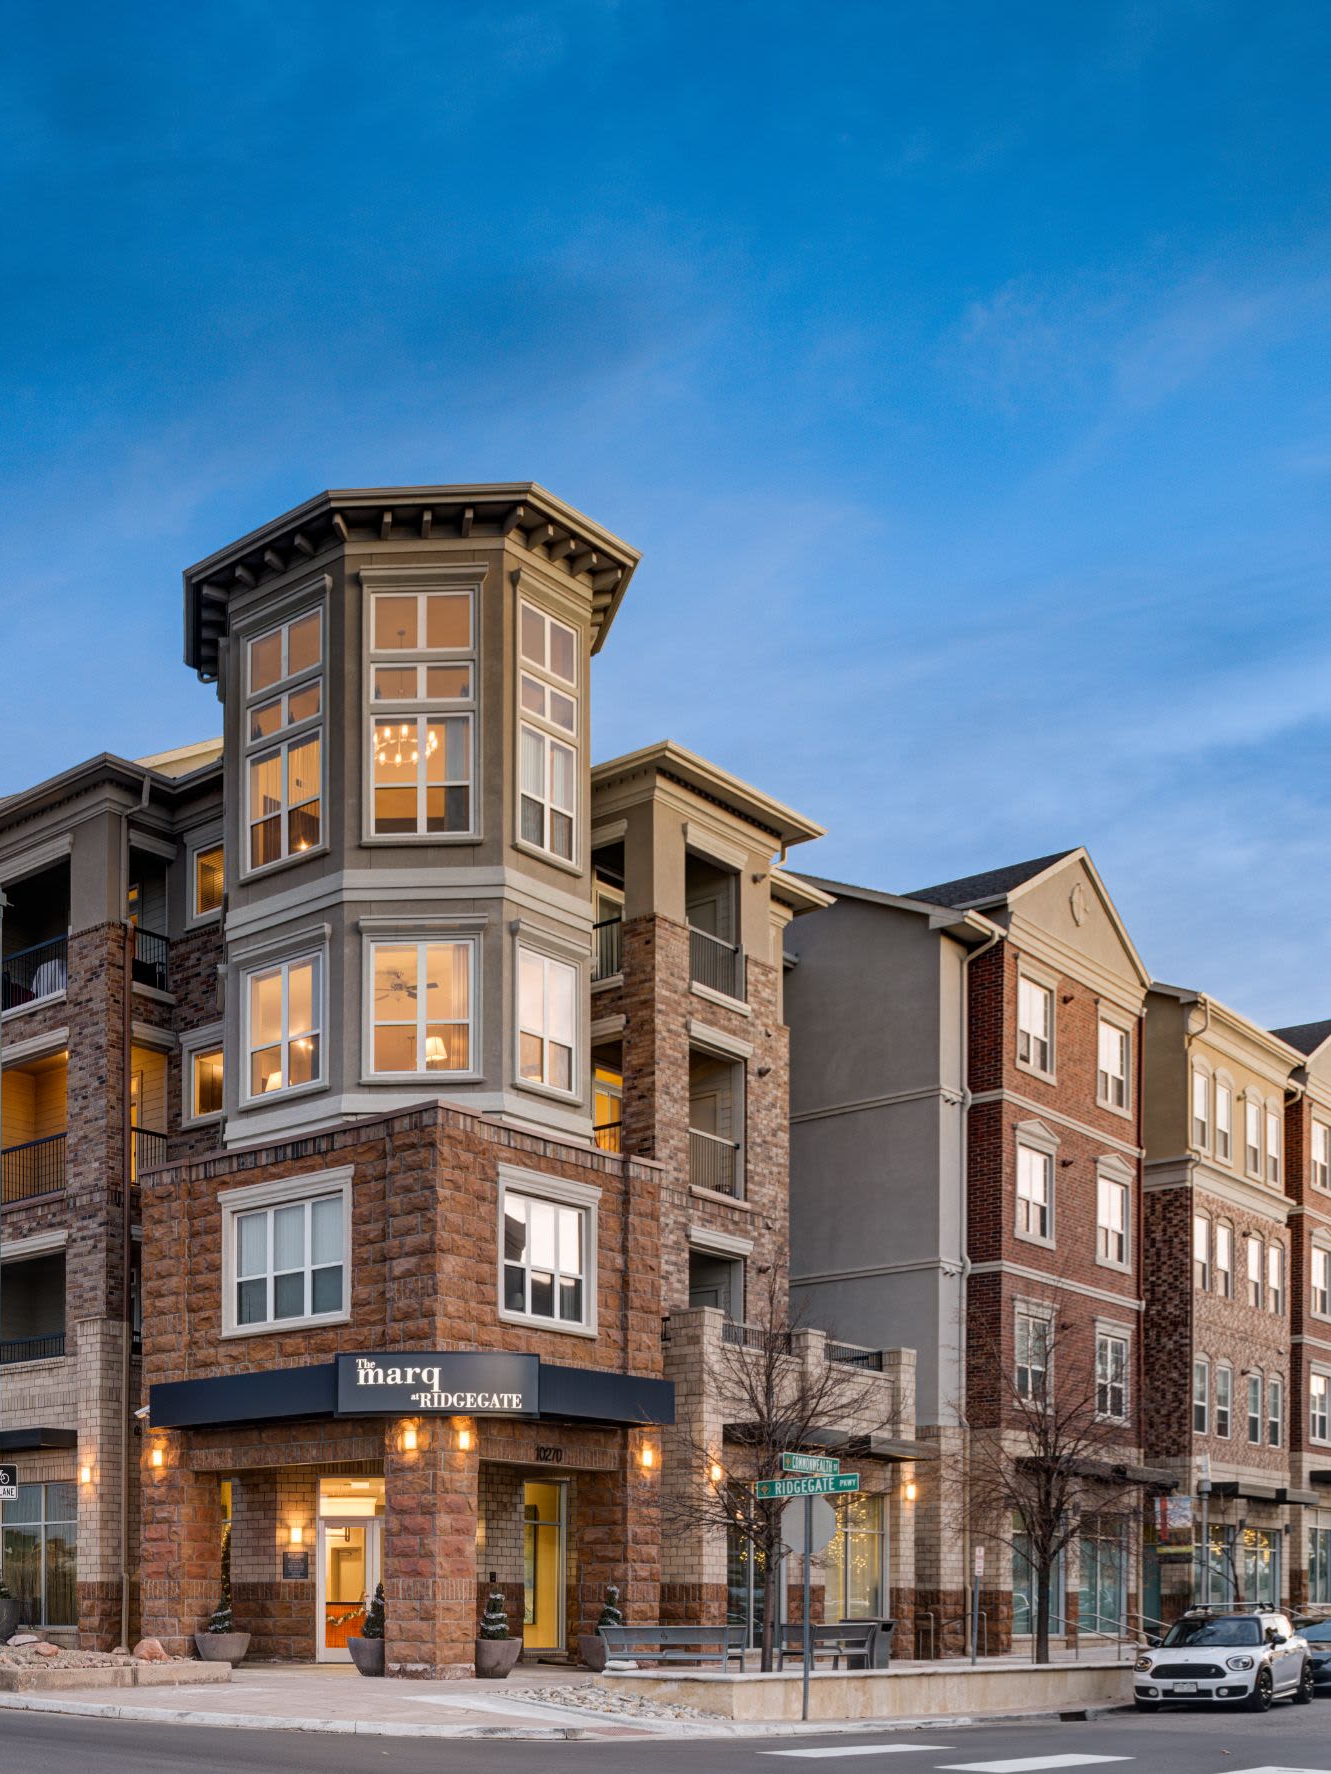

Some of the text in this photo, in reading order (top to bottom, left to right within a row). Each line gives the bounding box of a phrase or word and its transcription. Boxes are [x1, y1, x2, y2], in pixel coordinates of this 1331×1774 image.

[355, 1358, 376, 1369] The
[356, 1367, 442, 1392] marq
[419, 1393, 522, 1409] RIDGEGATE
[535, 1446, 563, 1463] 10270
[792, 1455, 833, 1473] COMMONWEALTH
[775, 1477, 856, 1494] RIDGEGATE PKWY
